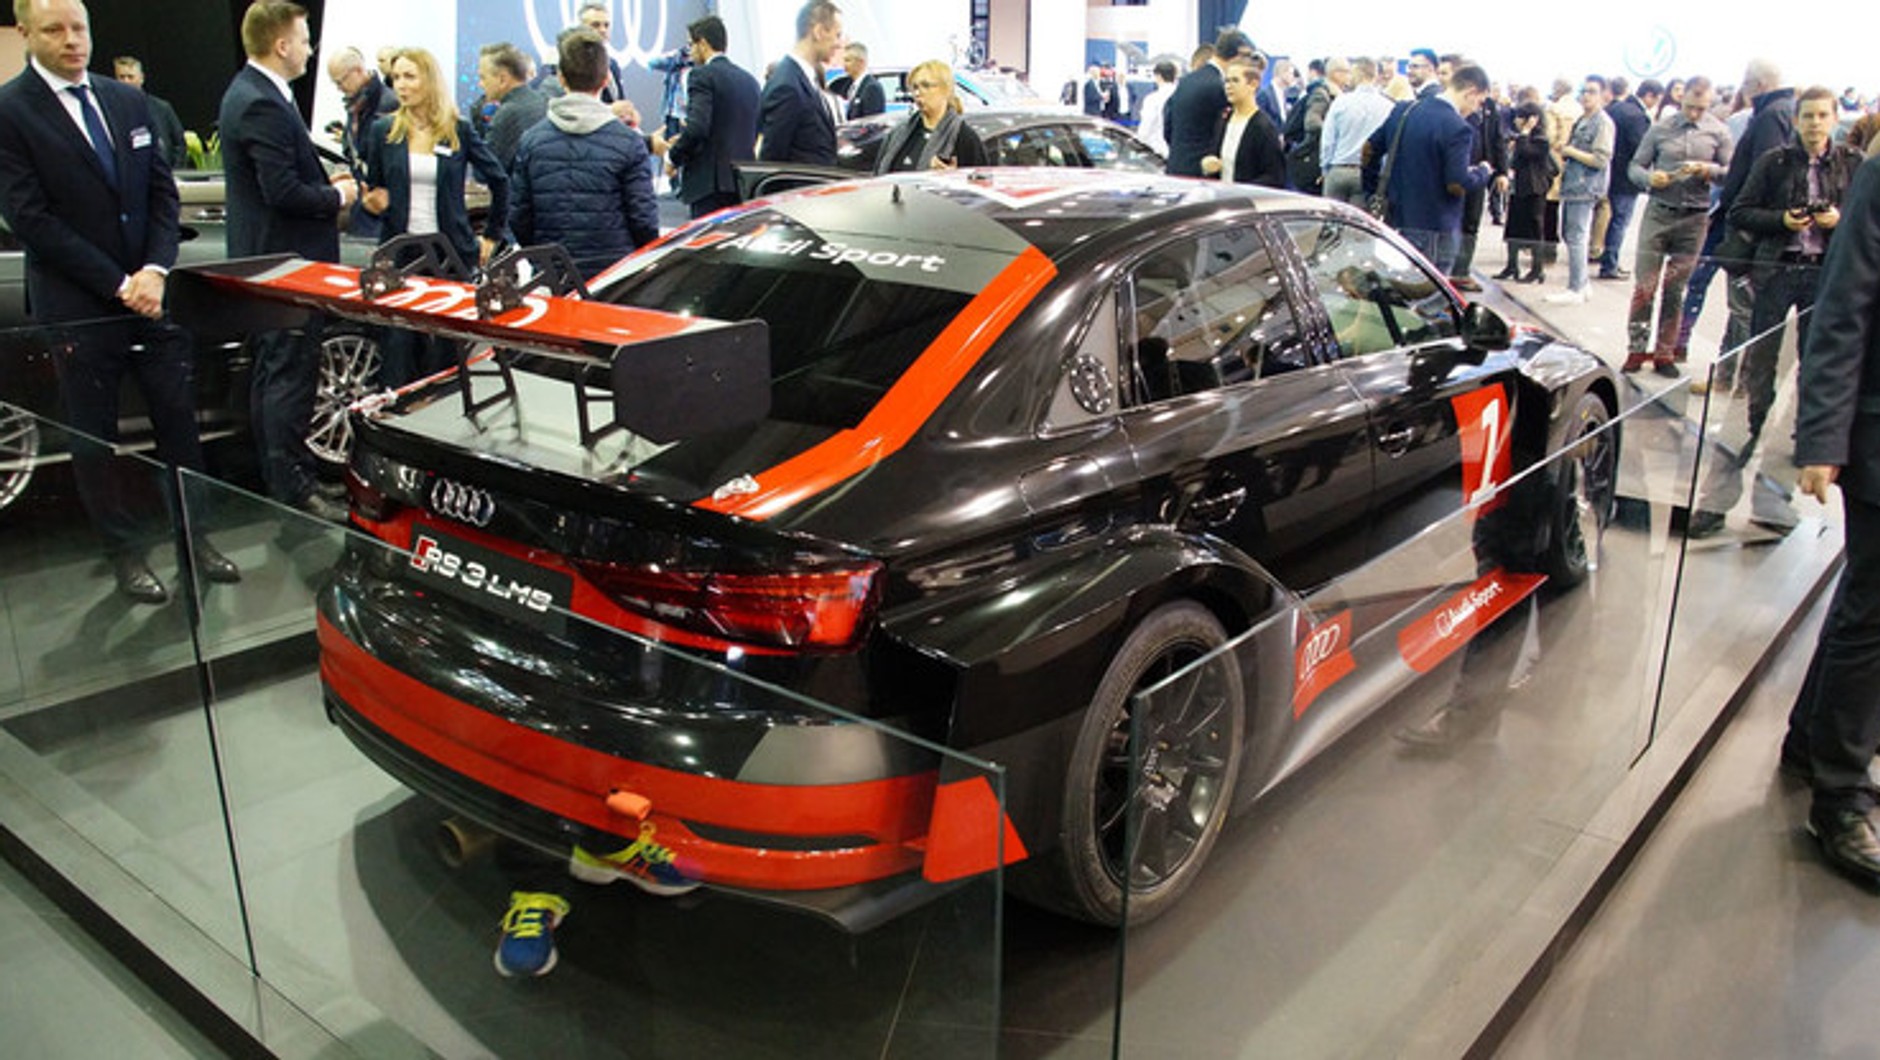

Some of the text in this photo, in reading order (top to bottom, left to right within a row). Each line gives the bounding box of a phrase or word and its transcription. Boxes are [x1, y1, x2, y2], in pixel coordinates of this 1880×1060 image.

[717, 234, 946, 272] Adi Sport
[425, 547, 553, 612] RS 3 LMS
[1469, 581, 1504, 608] Sport
